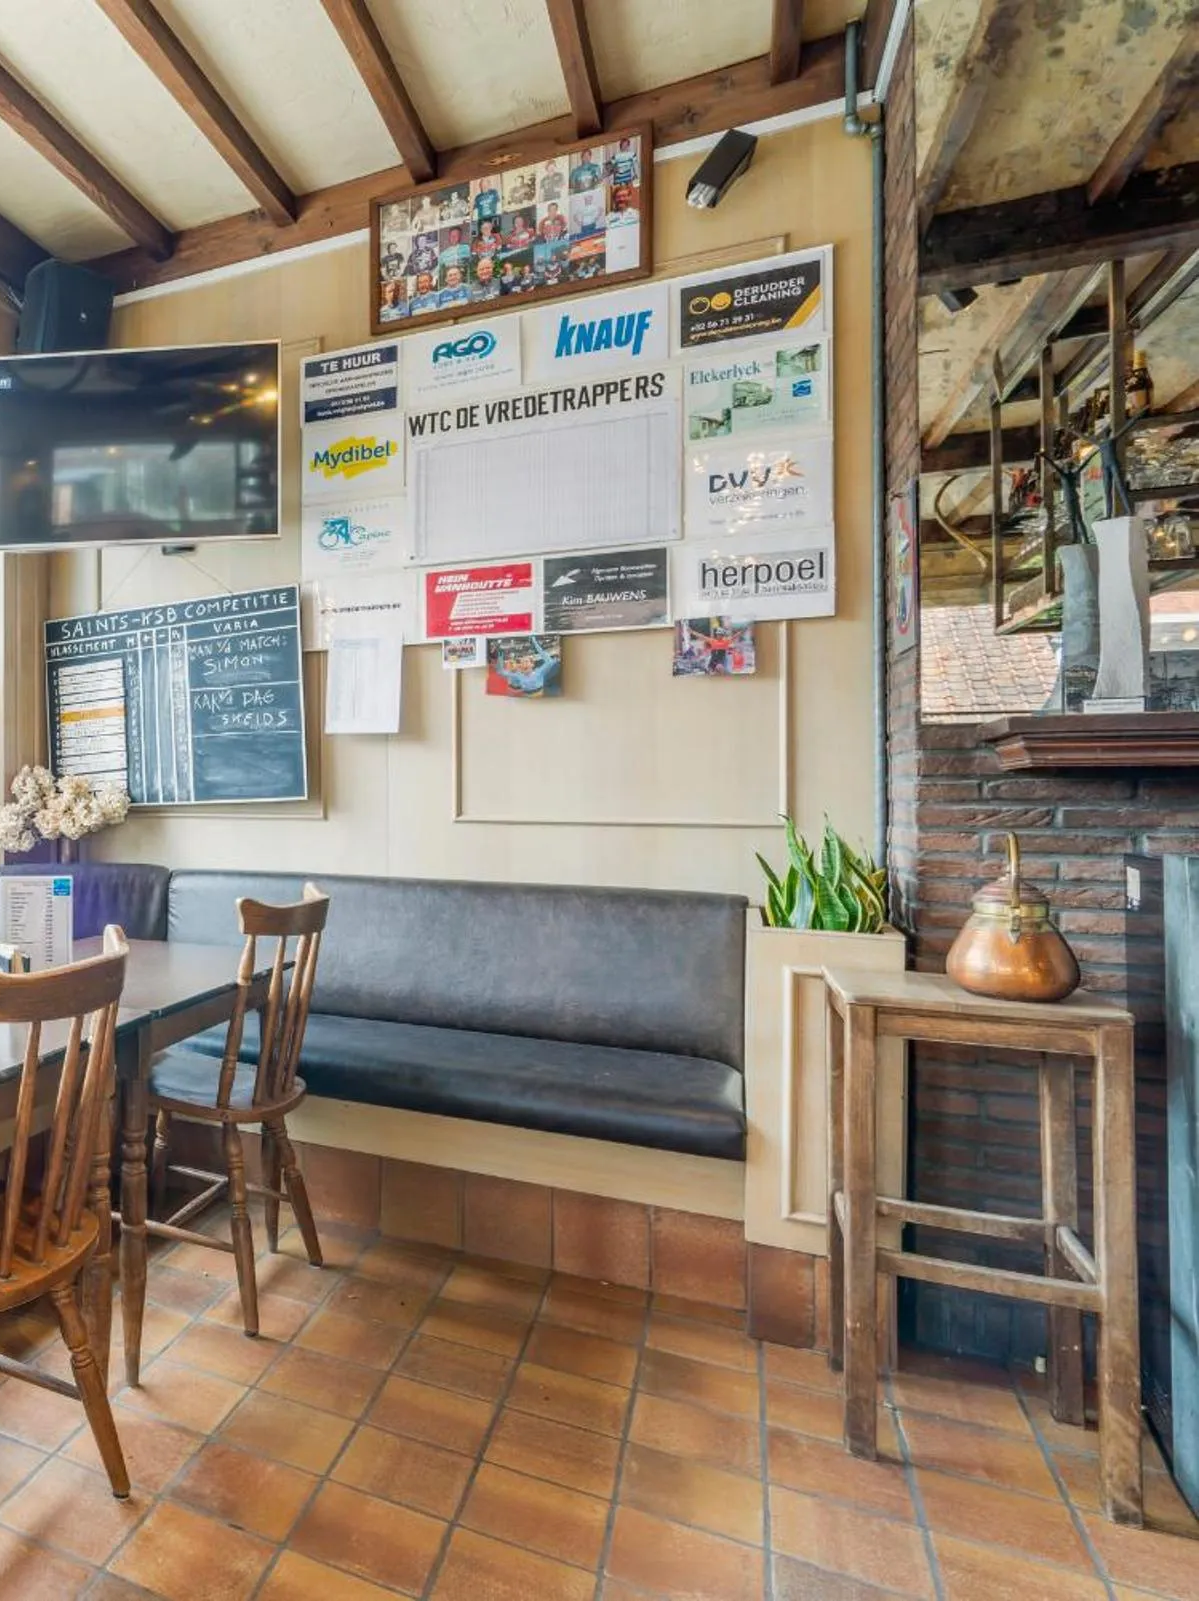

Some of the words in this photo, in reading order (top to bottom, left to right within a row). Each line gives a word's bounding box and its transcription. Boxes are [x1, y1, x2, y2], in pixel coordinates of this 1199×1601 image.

[734, 276, 806, 298] DERUDDER
[734, 287, 802, 307] CLEANING
[555, 309, 653, 358] KNAUF
[432, 331, 497, 363] AGO
[320, 360, 339, 373] TE
[342, 352, 382, 370] HUUR
[408, 410, 452, 437] WTC
[456, 405, 480, 430] DE
[485, 372, 666, 425] VREDETRAPPERS
[313, 440, 391, 469] Mydibel
[701, 551, 824, 594] herpoel
[184, 592, 288, 619] COMPETITIE
[562, 595, 583, 605] Kim
[586, 589, 648, 604] BAUWENS
[213, 619, 259, 634] VARIA
[203, 655, 264, 676] SIMON
